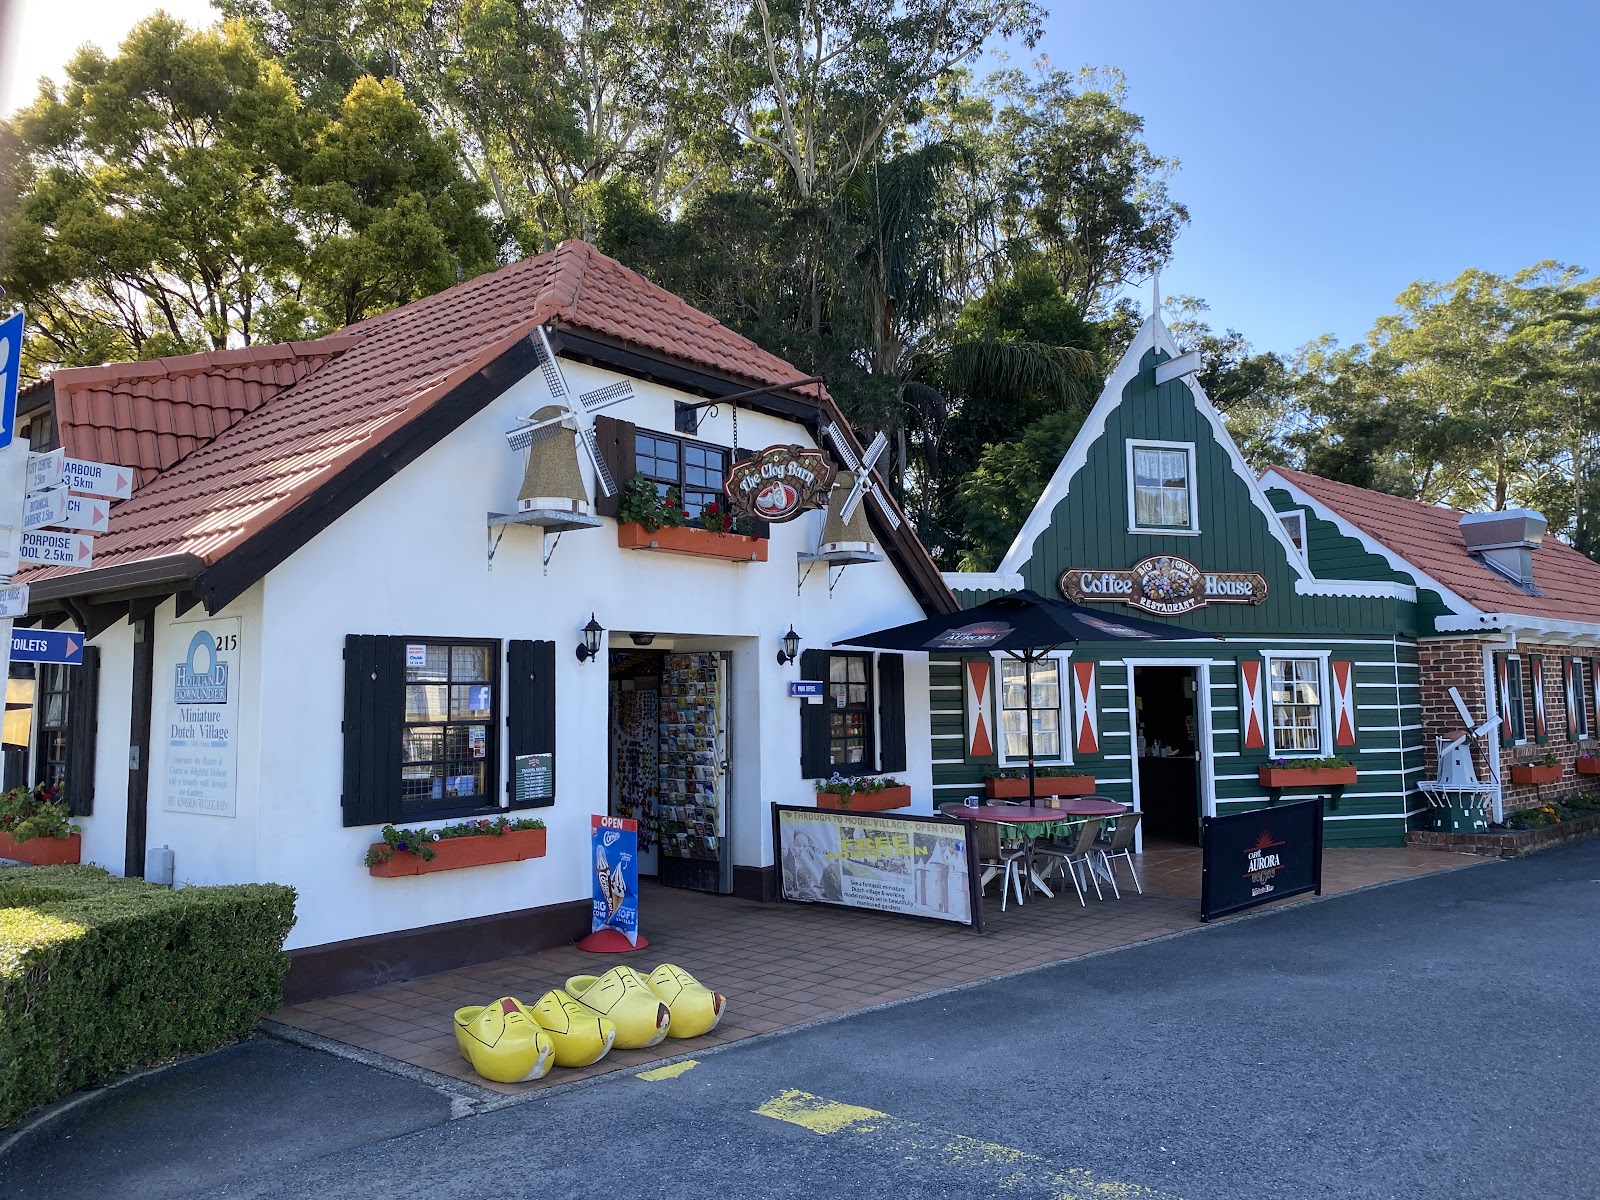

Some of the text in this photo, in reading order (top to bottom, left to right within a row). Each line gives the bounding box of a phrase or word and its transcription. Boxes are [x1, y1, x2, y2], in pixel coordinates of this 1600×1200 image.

[64, 462, 103, 479] ARBOUR
[740, 461, 816, 494] The Clog Barn
[64, 474, 93, 490] 3.5km
[23, 533, 71, 549] PORPOISE
[19, 546, 74, 562] OOL 2.5km
[1137, 561, 1153, 577] BIG
[1079, 572, 1253, 596] Coffee House
[1139, 596, 1195, 613] RESTAURANT
[215, 634, 237, 651] 215
[176, 665, 226, 688] HOLLAND
[175, 688, 226, 701] DOWNUNDER
[180, 708, 222, 723] Miniature
[170, 724, 229, 742] Dutch Village
[601, 816, 623, 830] OPEN
[793, 811, 831, 823] THROUGH
[832, 815, 843, 823] TO
[845, 816, 872, 827] MODEL
[873, 819, 908, 830] VILLAGE
[915, 823, 938, 833] OPEN
[940, 825, 964, 835] NOW
[840, 835, 908, 851] FREE
[1248, 854, 1280, 873] AURORA
[882, 885, 906, 893] miniature
[592, 909, 607, 919] CONE
[593, 900, 607, 912] BIG
[616, 909, 636, 920] SOFT
